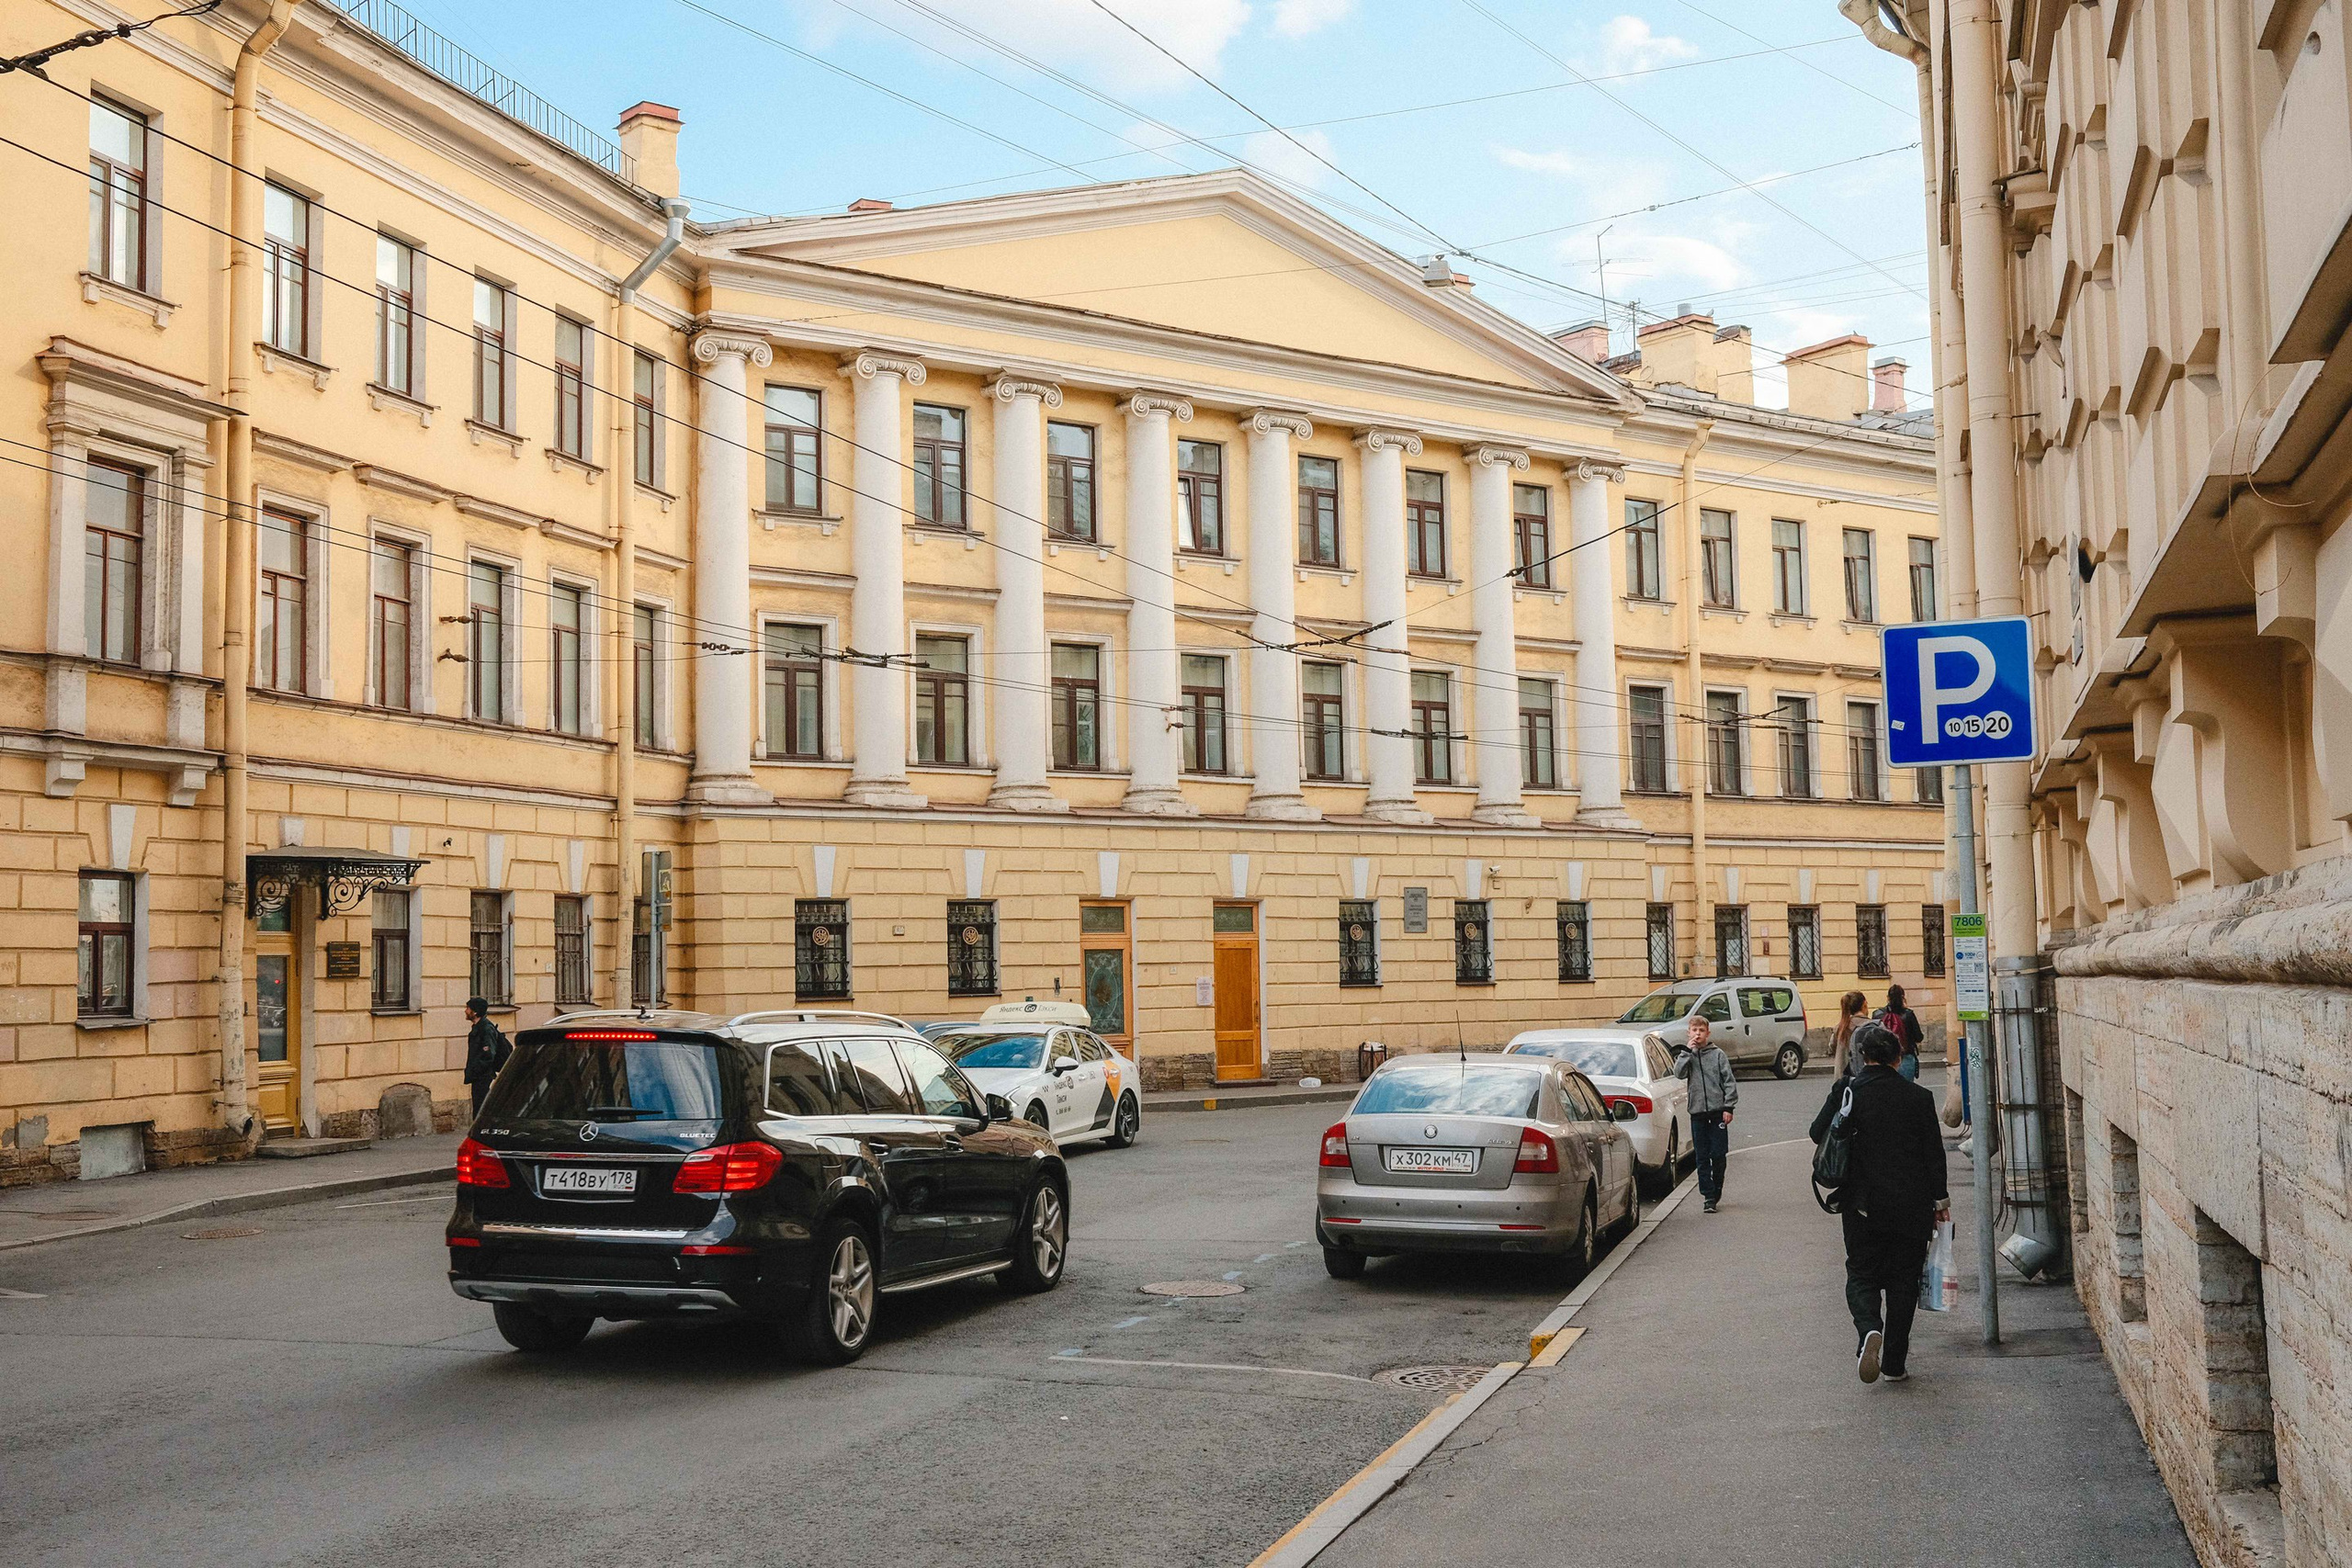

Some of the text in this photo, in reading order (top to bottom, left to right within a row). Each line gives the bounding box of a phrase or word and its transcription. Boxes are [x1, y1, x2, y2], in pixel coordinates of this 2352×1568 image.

[1917, 636, 1996, 744] P
[1949, 716, 2009, 733] 10 15 20
[1955, 917, 1983, 926] 7806
[1454, 1153, 1468, 1163] 47
[610, 1171, 632, 1184] 178
